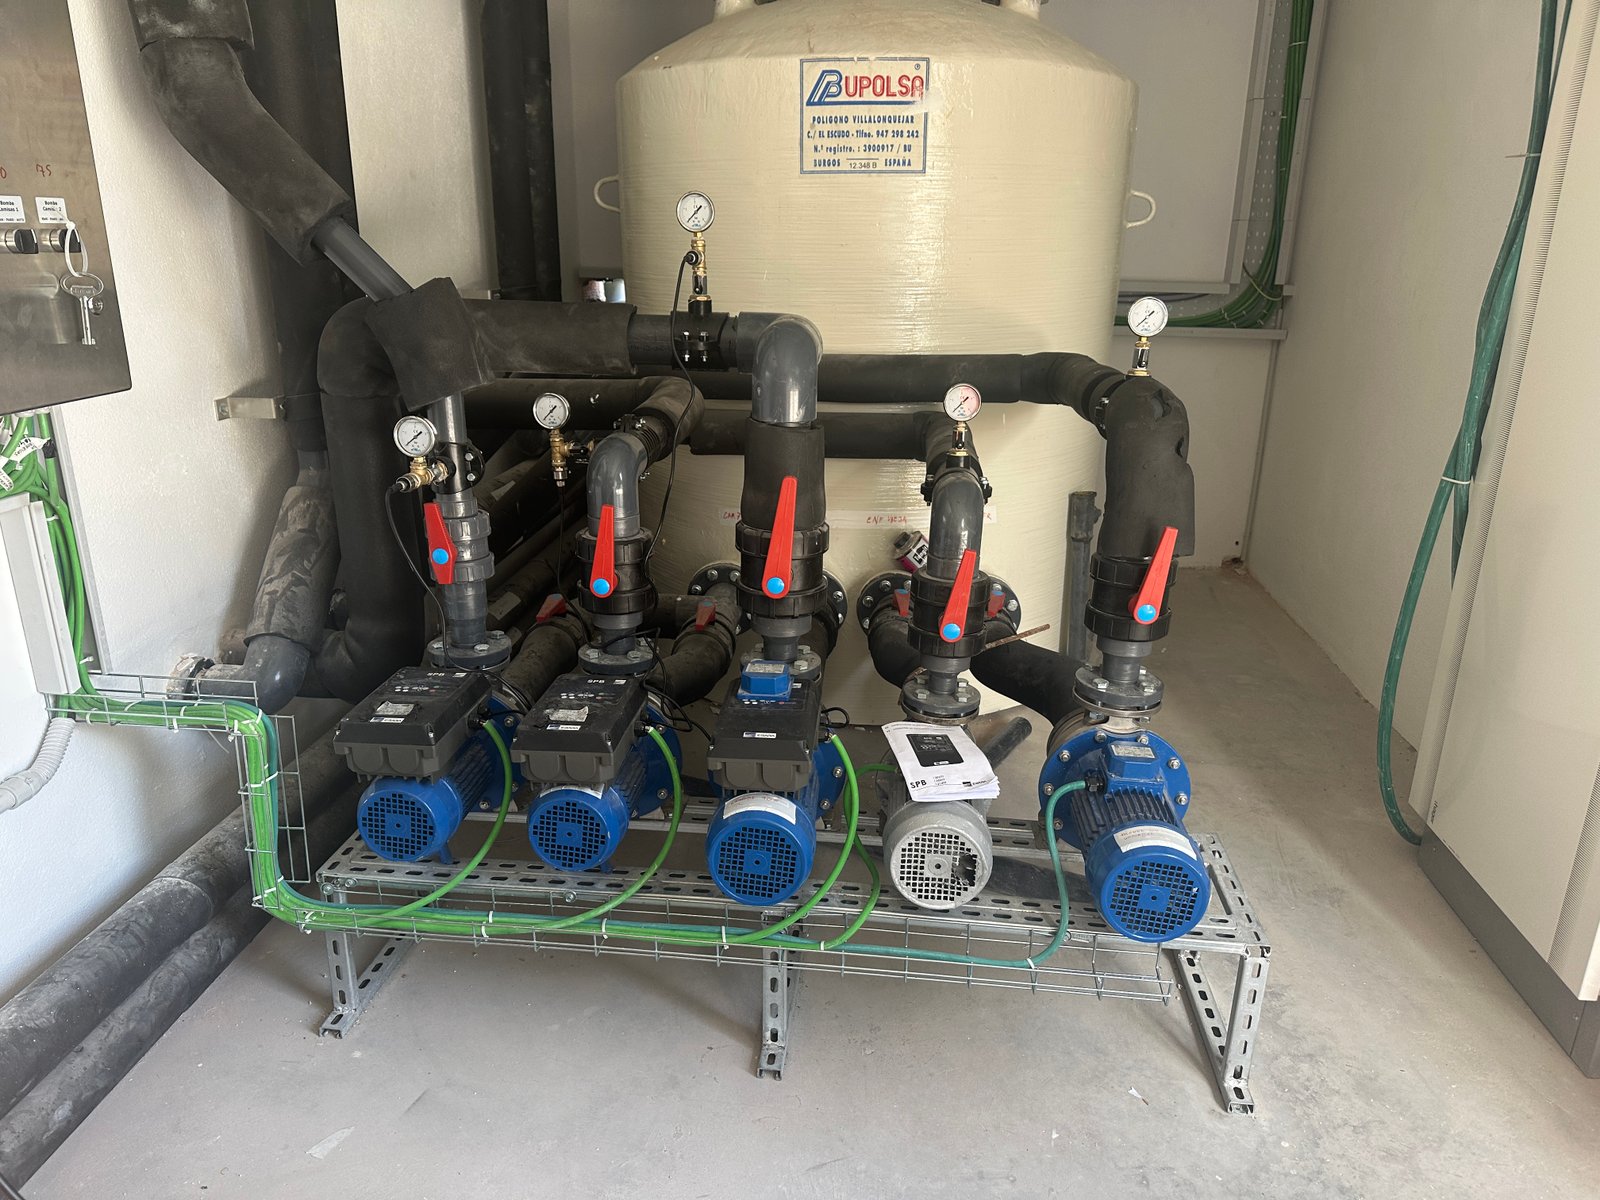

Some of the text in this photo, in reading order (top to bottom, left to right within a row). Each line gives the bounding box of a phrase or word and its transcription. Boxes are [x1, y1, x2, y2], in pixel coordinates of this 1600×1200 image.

[812, 115, 915, 124] POLIGONO VILLALONQUEJAR
[818, 130, 825, 138] EL
[827, 130, 850, 138] ESCUDO
[876, 130, 889, 138] 947
[891, 130, 904, 138] 298
[906, 130, 920, 138] 242
[863, 144, 894, 152] 3900917
[903, 144, 912, 152] BU
[813, 158, 841, 167] BURGOS
[884, 156, 912, 167] ESPAÑA
[909, 779, 927, 789] SPB
